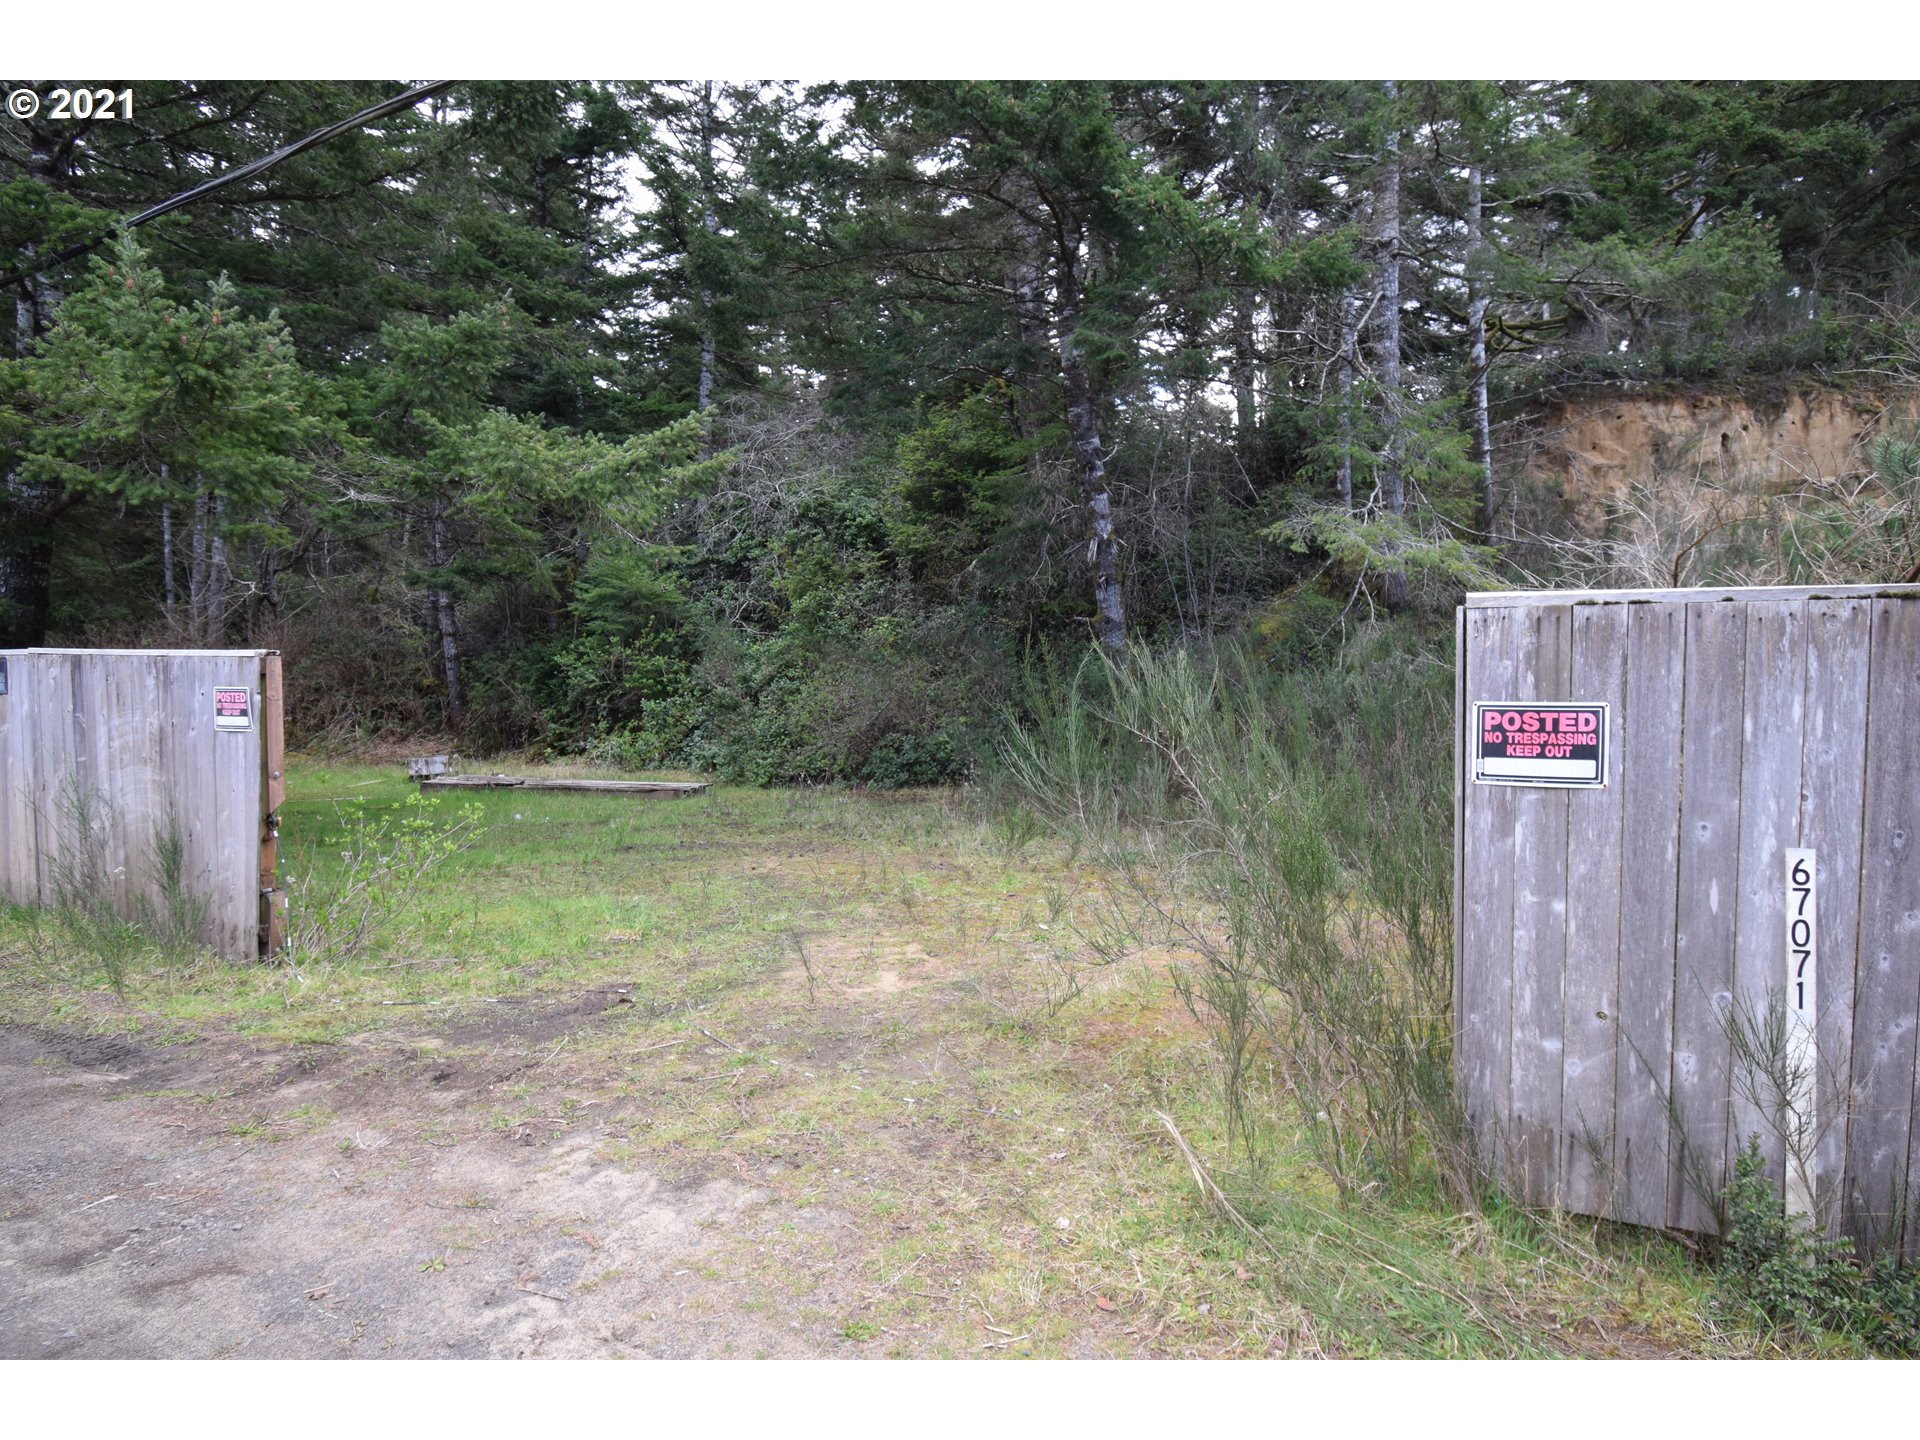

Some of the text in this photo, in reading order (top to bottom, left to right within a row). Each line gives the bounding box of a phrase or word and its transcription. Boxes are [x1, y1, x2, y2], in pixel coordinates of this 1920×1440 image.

[216, 692, 246, 703] POSTED
[1484, 711, 1597, 731] POSTED
[1484, 732, 1597, 745] NO TRESPASSING
[1506, 745, 1572, 758] KEEP OUT
[1791, 858, 1811, 1009] 67071
